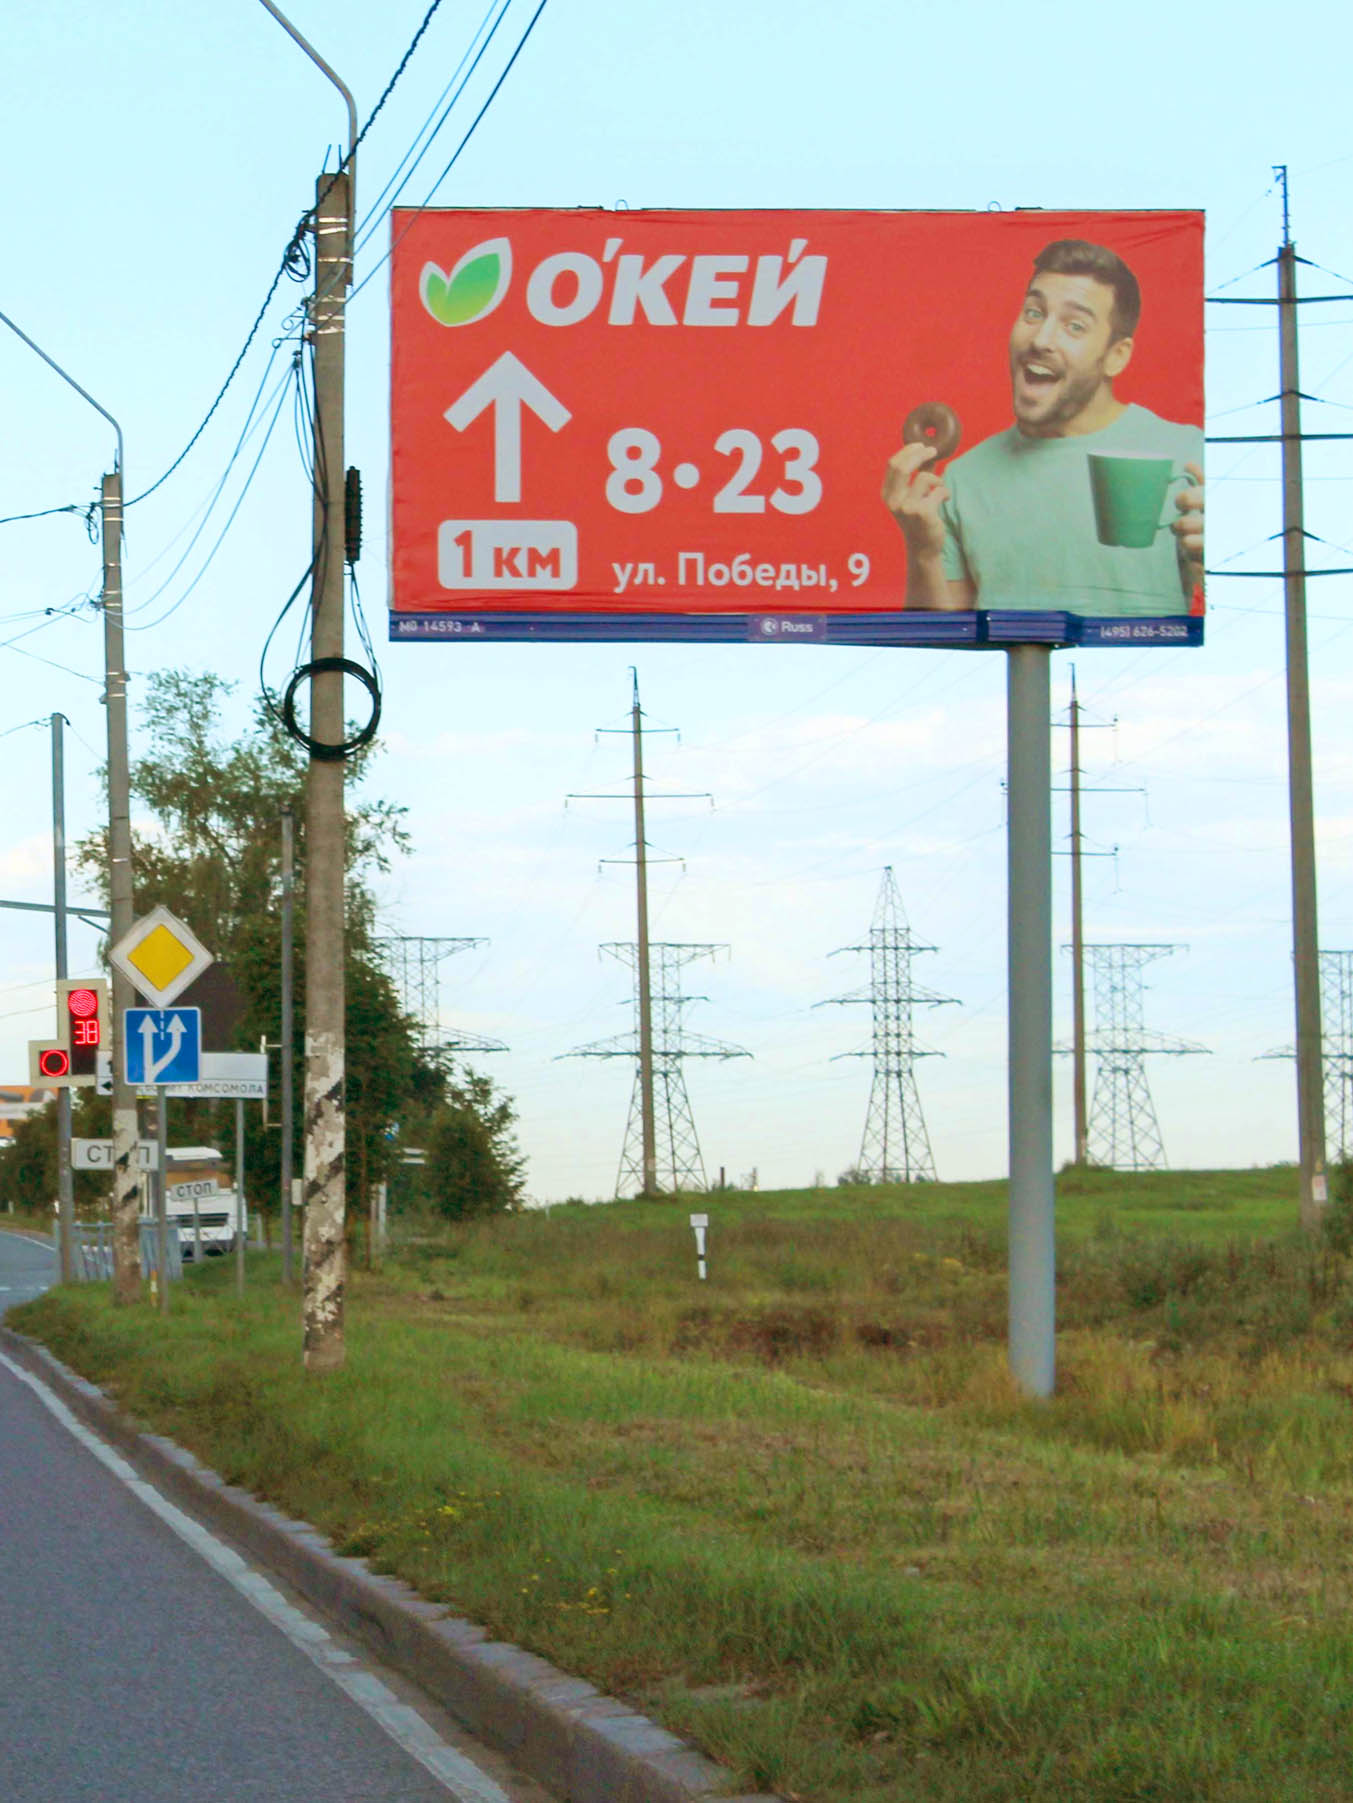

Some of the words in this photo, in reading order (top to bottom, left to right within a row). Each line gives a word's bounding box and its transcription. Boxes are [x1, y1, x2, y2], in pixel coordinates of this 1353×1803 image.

[452, 529, 474, 578] 1
[611, 561, 666, 594] ул.
[678, 551, 839, 592] Победы,
[848, 552, 871, 587] 9
[781, 621, 814, 632] Russ
[74, 1020, 98, 1045] 38
[87, 1145, 151, 1163] СТП
[176, 1182, 212, 1198] СТОП
